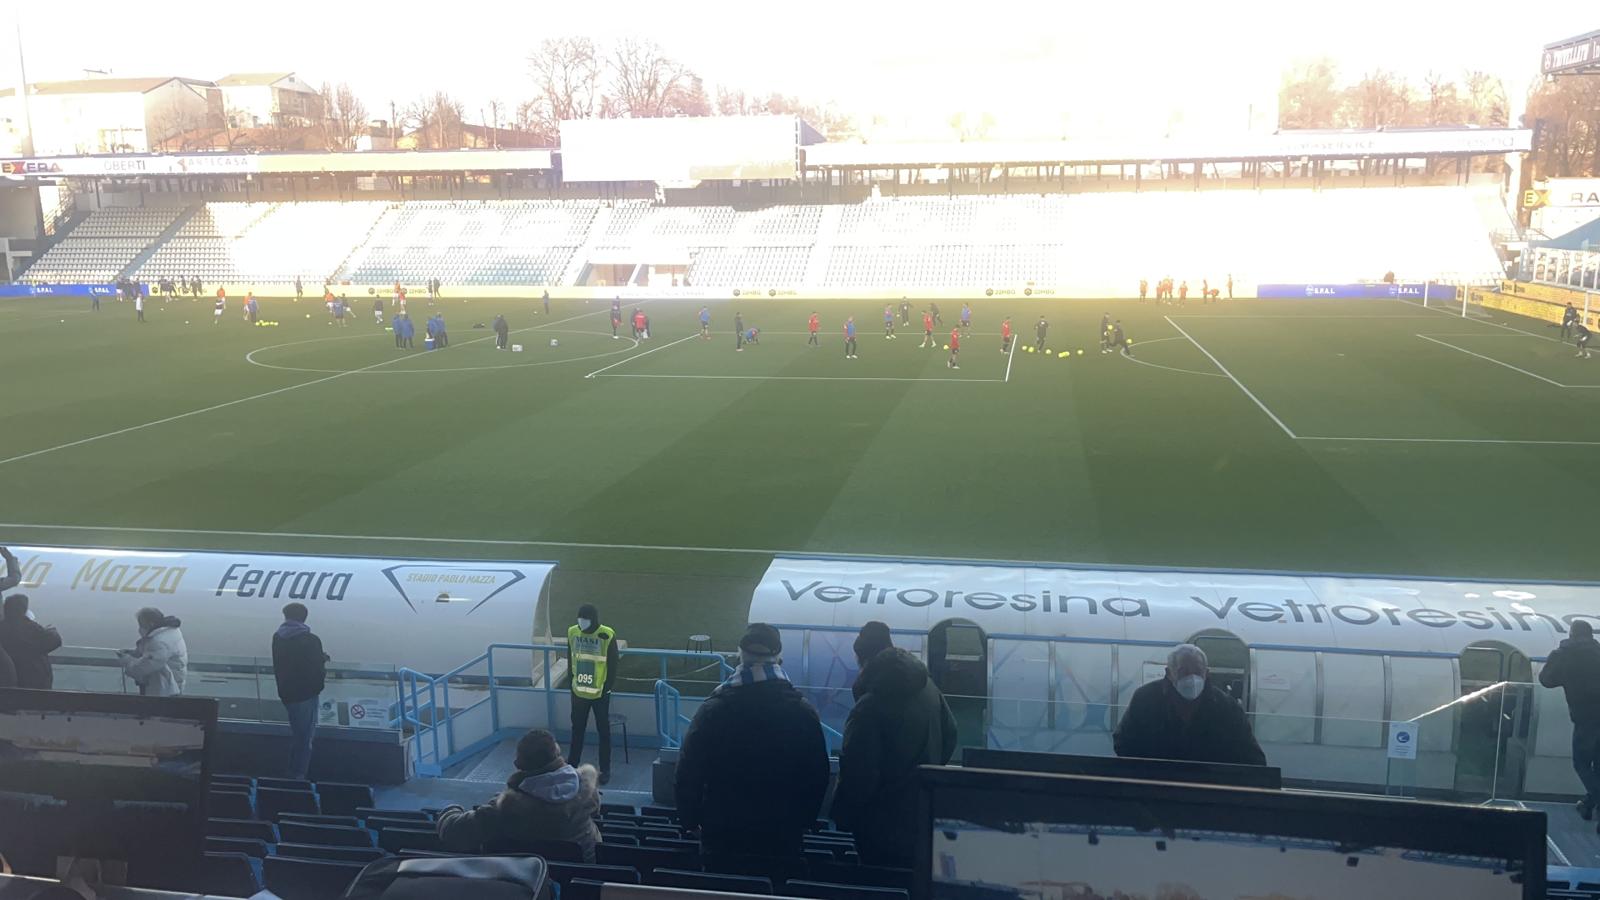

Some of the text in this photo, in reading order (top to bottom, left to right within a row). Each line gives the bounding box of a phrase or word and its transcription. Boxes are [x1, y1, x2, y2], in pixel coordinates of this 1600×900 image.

[1, 160, 63, 175] EXERA
[70, 558, 188, 595] Mazza
[214, 563, 353, 601] Ferrara
[406, 572, 437, 583] STADIO
[466, 575, 496, 585] MAZZA
[780, 579, 1151, 618] Vetroresina
[576, 673, 593, 686] 095
